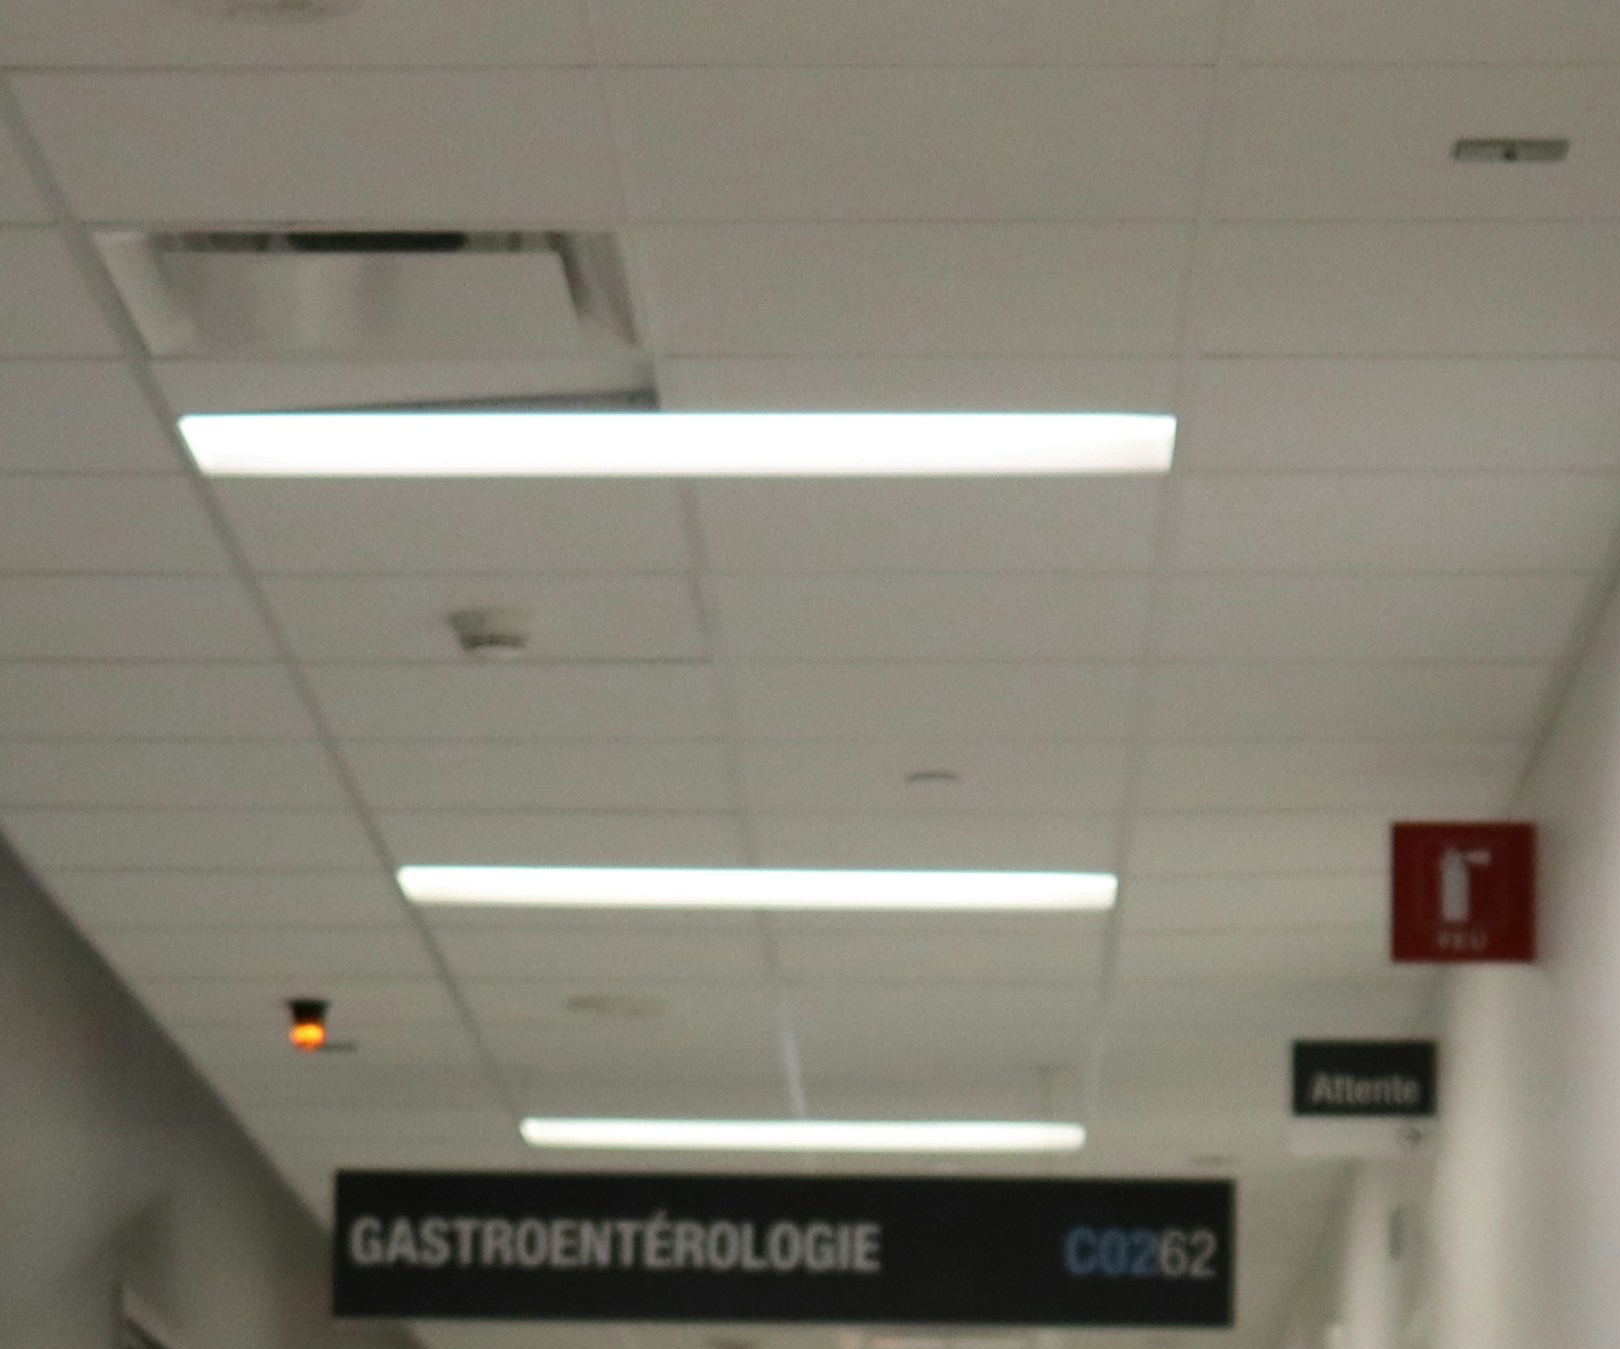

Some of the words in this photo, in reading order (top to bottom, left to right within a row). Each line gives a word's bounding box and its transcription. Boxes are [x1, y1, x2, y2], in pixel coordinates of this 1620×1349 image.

[1309, 1071, 1420, 1104] Attente
[349, 1210, 881, 1273] GASTROENTÉROLOGIE
[1063, 1226, 1217, 1277] C0262
